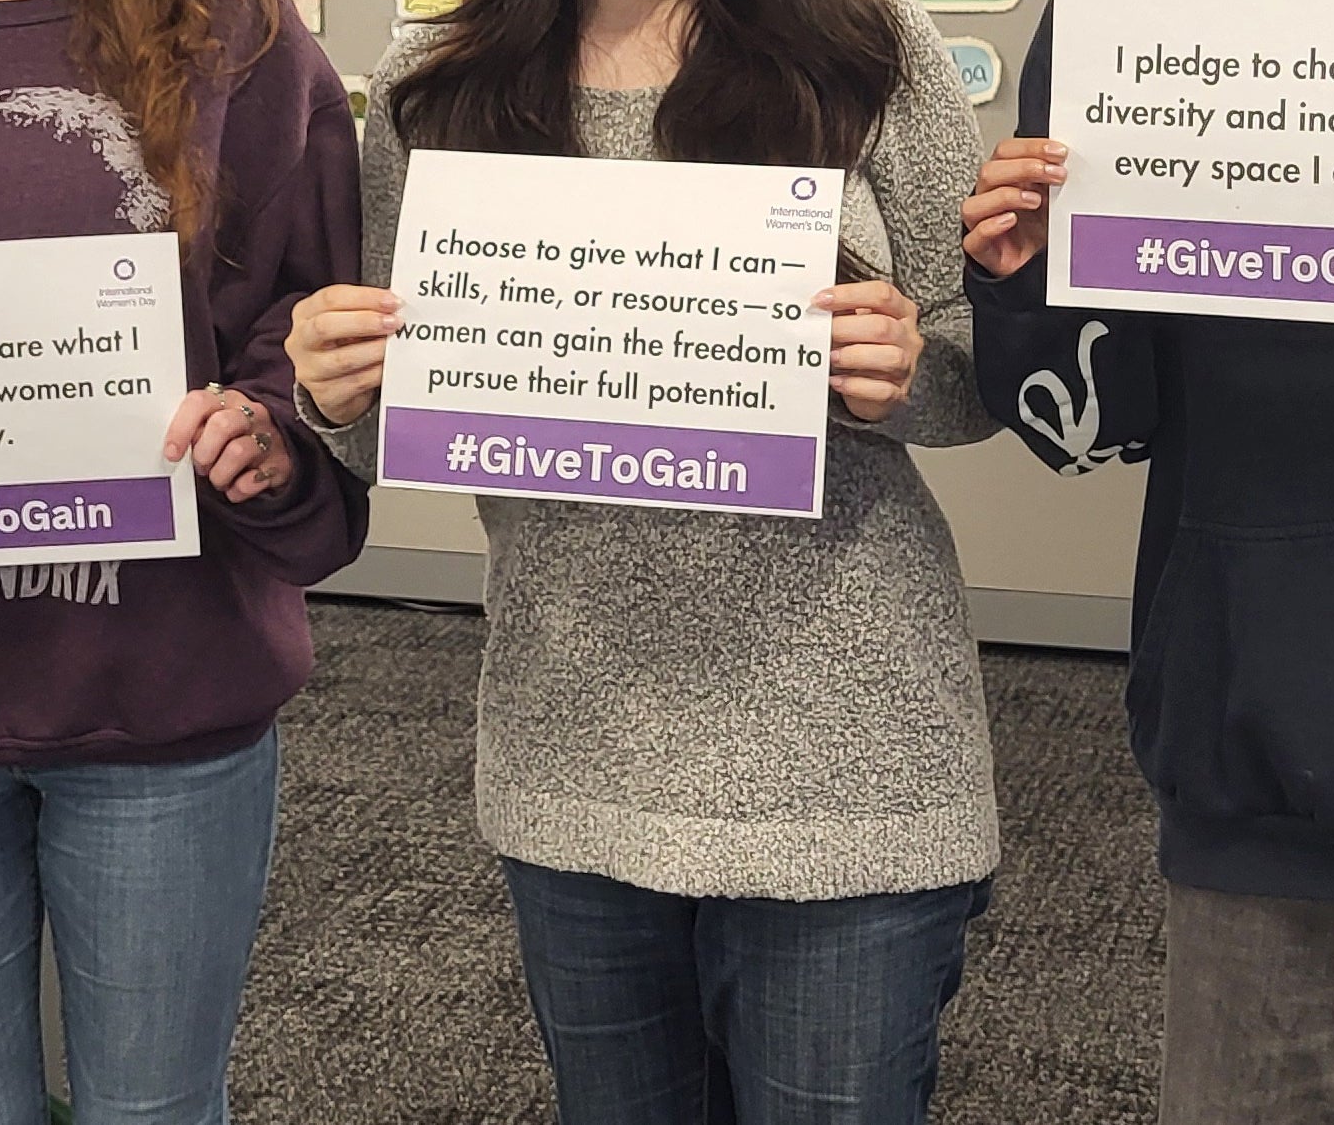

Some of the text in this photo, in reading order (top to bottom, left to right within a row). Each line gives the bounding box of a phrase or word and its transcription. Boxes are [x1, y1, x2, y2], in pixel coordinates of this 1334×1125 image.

[1117, 46, 1123, 73] I
[1136, 44, 1240, 85] pledge
[1252, 53, 1280, 78] to
[1086, 93, 1215, 137] diversity
[1226, 99, 1286, 130] and
[1115, 157, 1200, 187] every
[1212, 161, 1300, 189] space
[1314, 155, 1319, 184] I
[765, 219, 812, 231] Women's
[770, 206, 834, 219] International
[420, 230, 427, 252] I
[436, 229, 526, 259] choose
[537, 240, 560, 260] to
[569, 239, 625, 270] give
[635, 241, 703, 269] what
[712, 247, 719, 270] I
[418, 270, 488, 305] skills,
[500, 277, 563, 310] time,
[574, 290, 602, 307] or
[52, 327, 123, 355] what
[132, 327, 138, 350] I
[394, 321, 821, 367] women can gain the freedom to
[104, 378, 151, 396] can
[428, 365, 775, 410] pursue their full potential.
[447, 434, 746, 491] #GiveToGain
